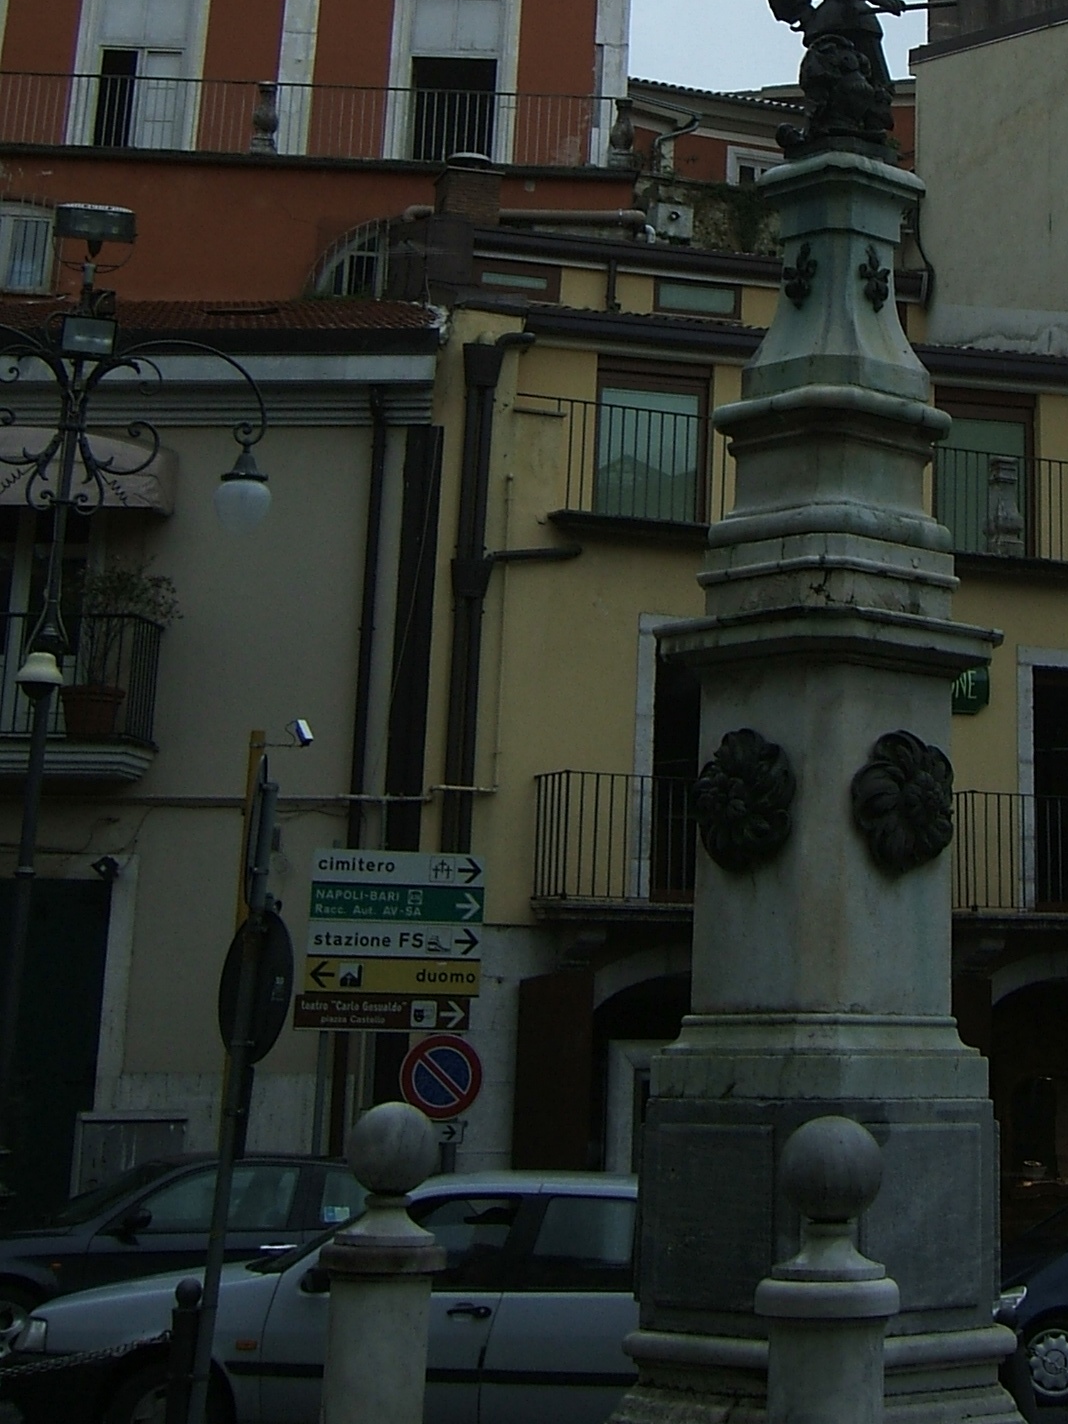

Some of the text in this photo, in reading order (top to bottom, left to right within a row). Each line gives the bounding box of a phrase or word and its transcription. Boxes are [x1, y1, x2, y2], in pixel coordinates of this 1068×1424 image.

[318, 857, 395, 873] cimitero
[315, 889, 400, 902] NAPOLI-BARI
[314, 903, 346, 915] Racc.
[314, 932, 424, 949] stazione FS
[416, 969, 476, 984] duomo
[301, 1000, 329, 1011] teatro
